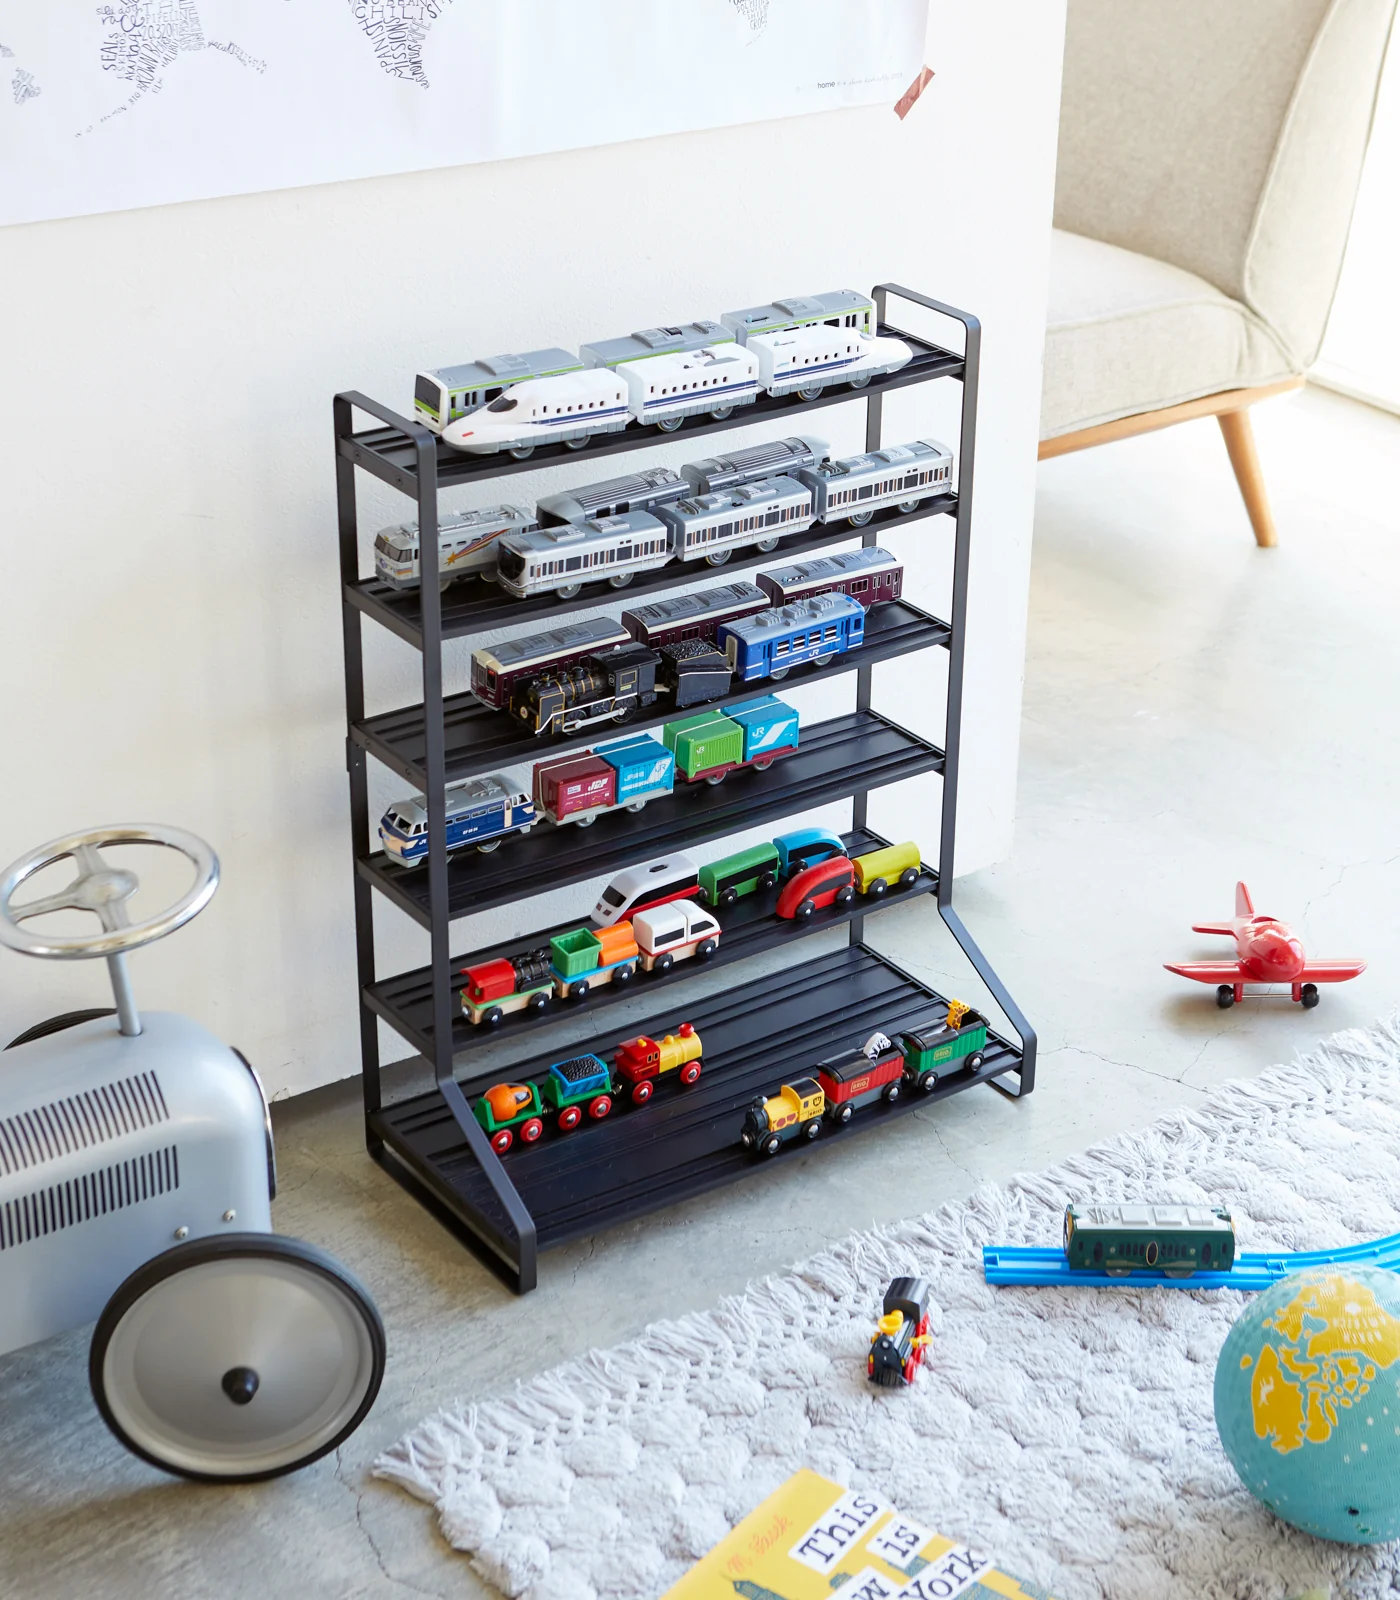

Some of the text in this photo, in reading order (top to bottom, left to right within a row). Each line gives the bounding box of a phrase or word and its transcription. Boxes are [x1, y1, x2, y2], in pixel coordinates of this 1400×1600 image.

[100, 32, 119, 71] SEALS
[357, 17, 397, 77] SPANISH
[382, 16, 415, 81] MISSIONS
[808, 648, 820, 658] JR
[696, 745, 705, 754] JR
[751, 726, 765, 737] JR
[798, 1496, 878, 1564] This
[876, 1525, 920, 1558] is
[898, 1549, 988, 1600] York
